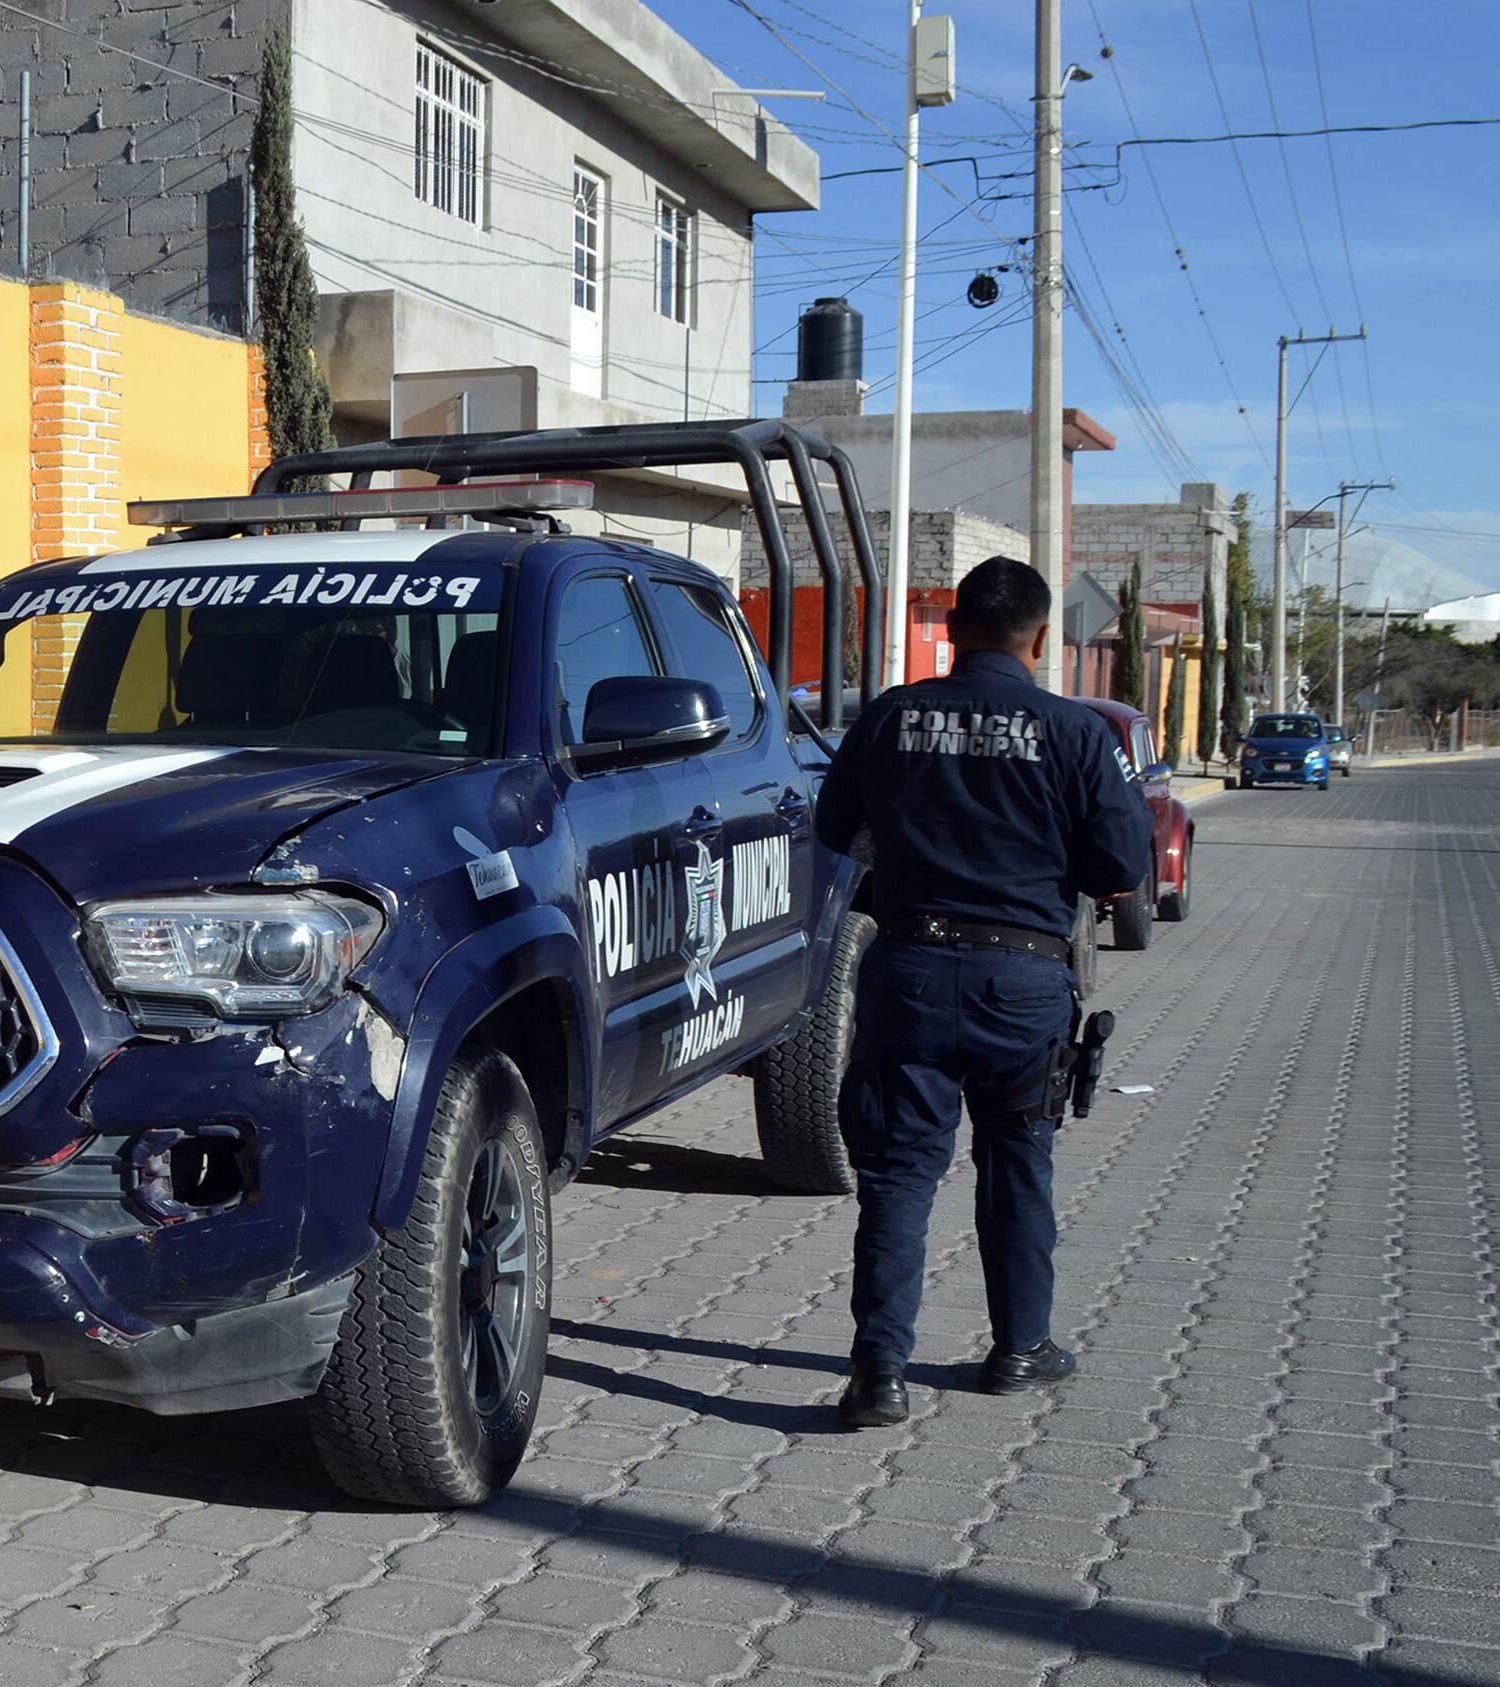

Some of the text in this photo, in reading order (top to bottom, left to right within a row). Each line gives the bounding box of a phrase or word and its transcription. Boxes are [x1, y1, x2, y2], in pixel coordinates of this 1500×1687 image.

[898, 731, 1042, 762] MUNICIPAL
[901, 710, 1043, 741] POLICÍA
[588, 834, 791, 984] POLICÍA MUNICIPAL
[658, 989, 744, 1077] TEHUACÁN
